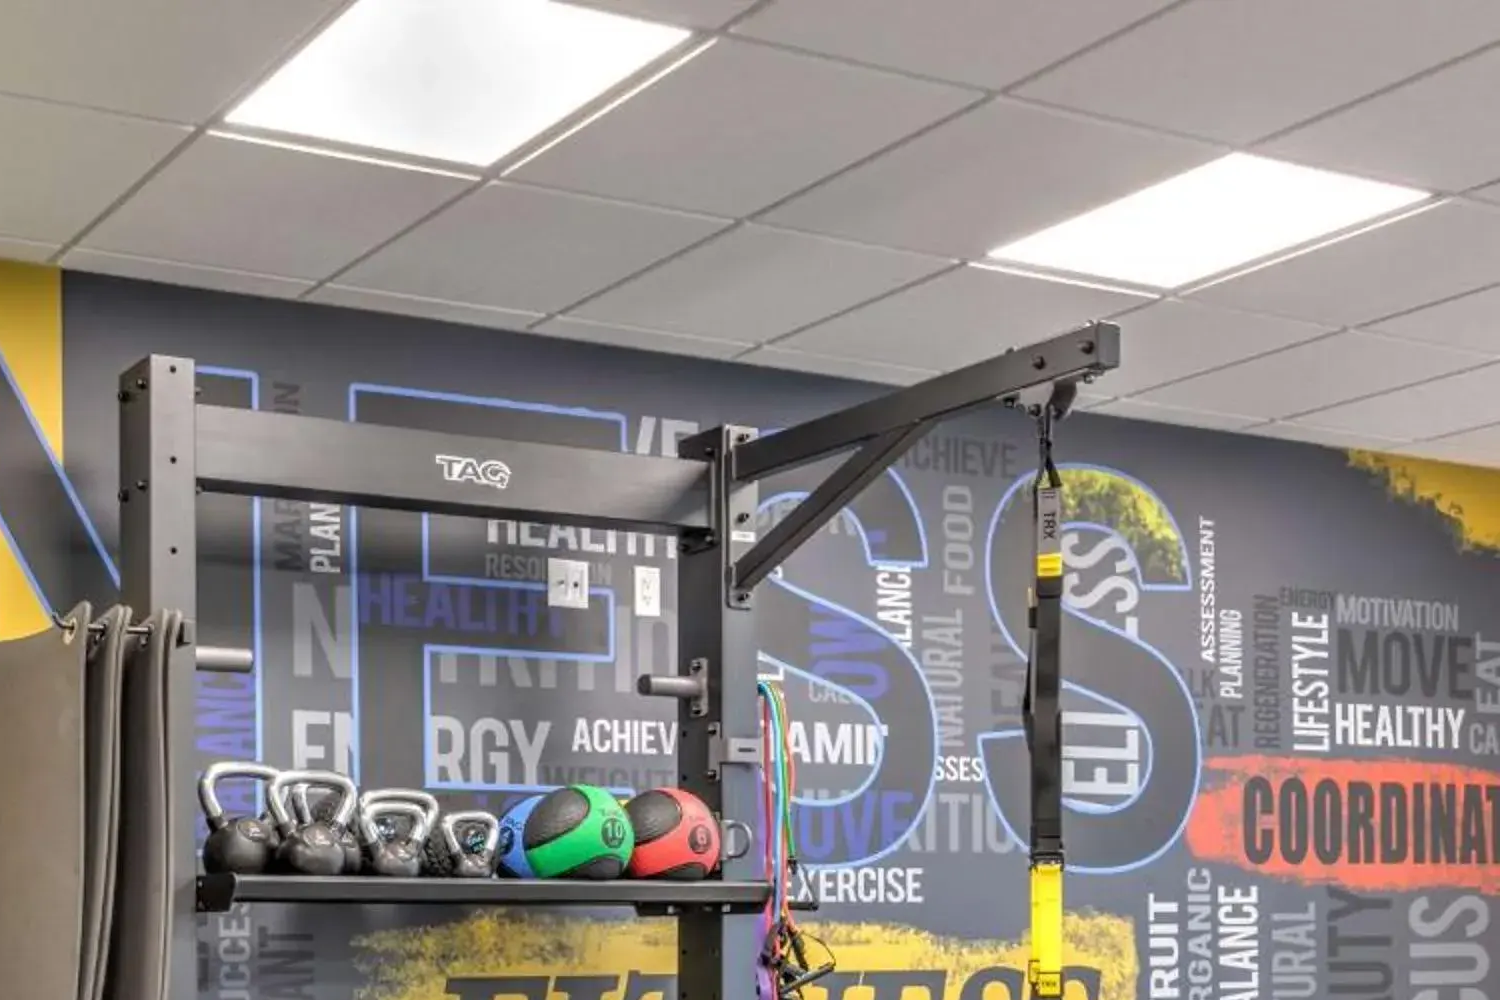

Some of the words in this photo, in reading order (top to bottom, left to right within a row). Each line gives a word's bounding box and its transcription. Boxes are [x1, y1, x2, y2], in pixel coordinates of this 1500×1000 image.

[435, 454, 513, 490] TAG
[943, 484, 976, 596] FOOD
[1199, 515, 1217, 664] ASSESSMENT
[1335, 593, 1460, 633] MOTIVATION
[1219, 608, 1244, 699] PLANNING
[1290, 611, 1330, 753] LIFESTYLE
[1336, 628, 1475, 700] MOVE
[571, 717, 678, 756] ACHIEV
[1334, 702, 1466, 750] HEALTHY
